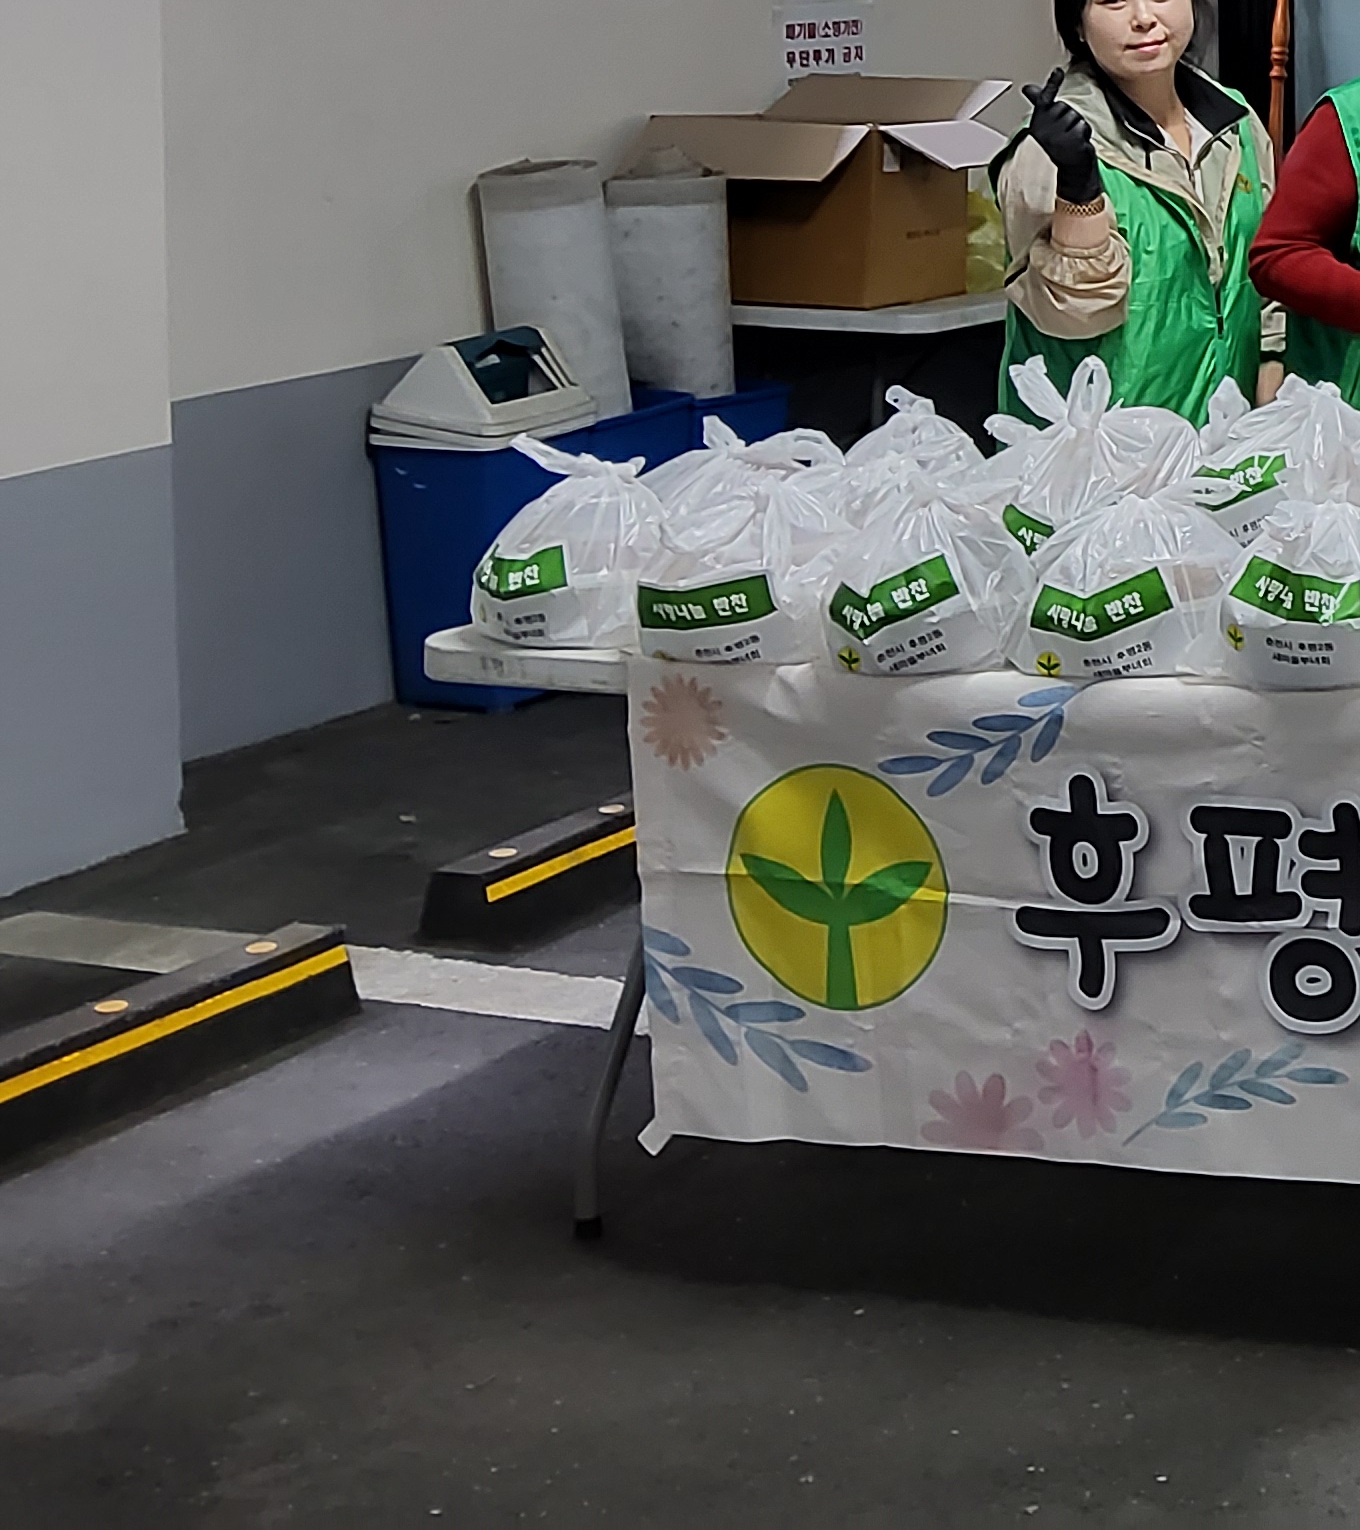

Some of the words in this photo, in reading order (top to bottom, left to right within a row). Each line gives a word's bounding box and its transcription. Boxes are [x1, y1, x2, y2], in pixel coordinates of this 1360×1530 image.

[786, 47, 836, 69] 무단투기
[842, 45, 864, 64] 금지
[711, 592, 749, 617] 반찬
[891, 577, 931, 610] 반찬
[1104, 591, 1145, 624] 반찬
